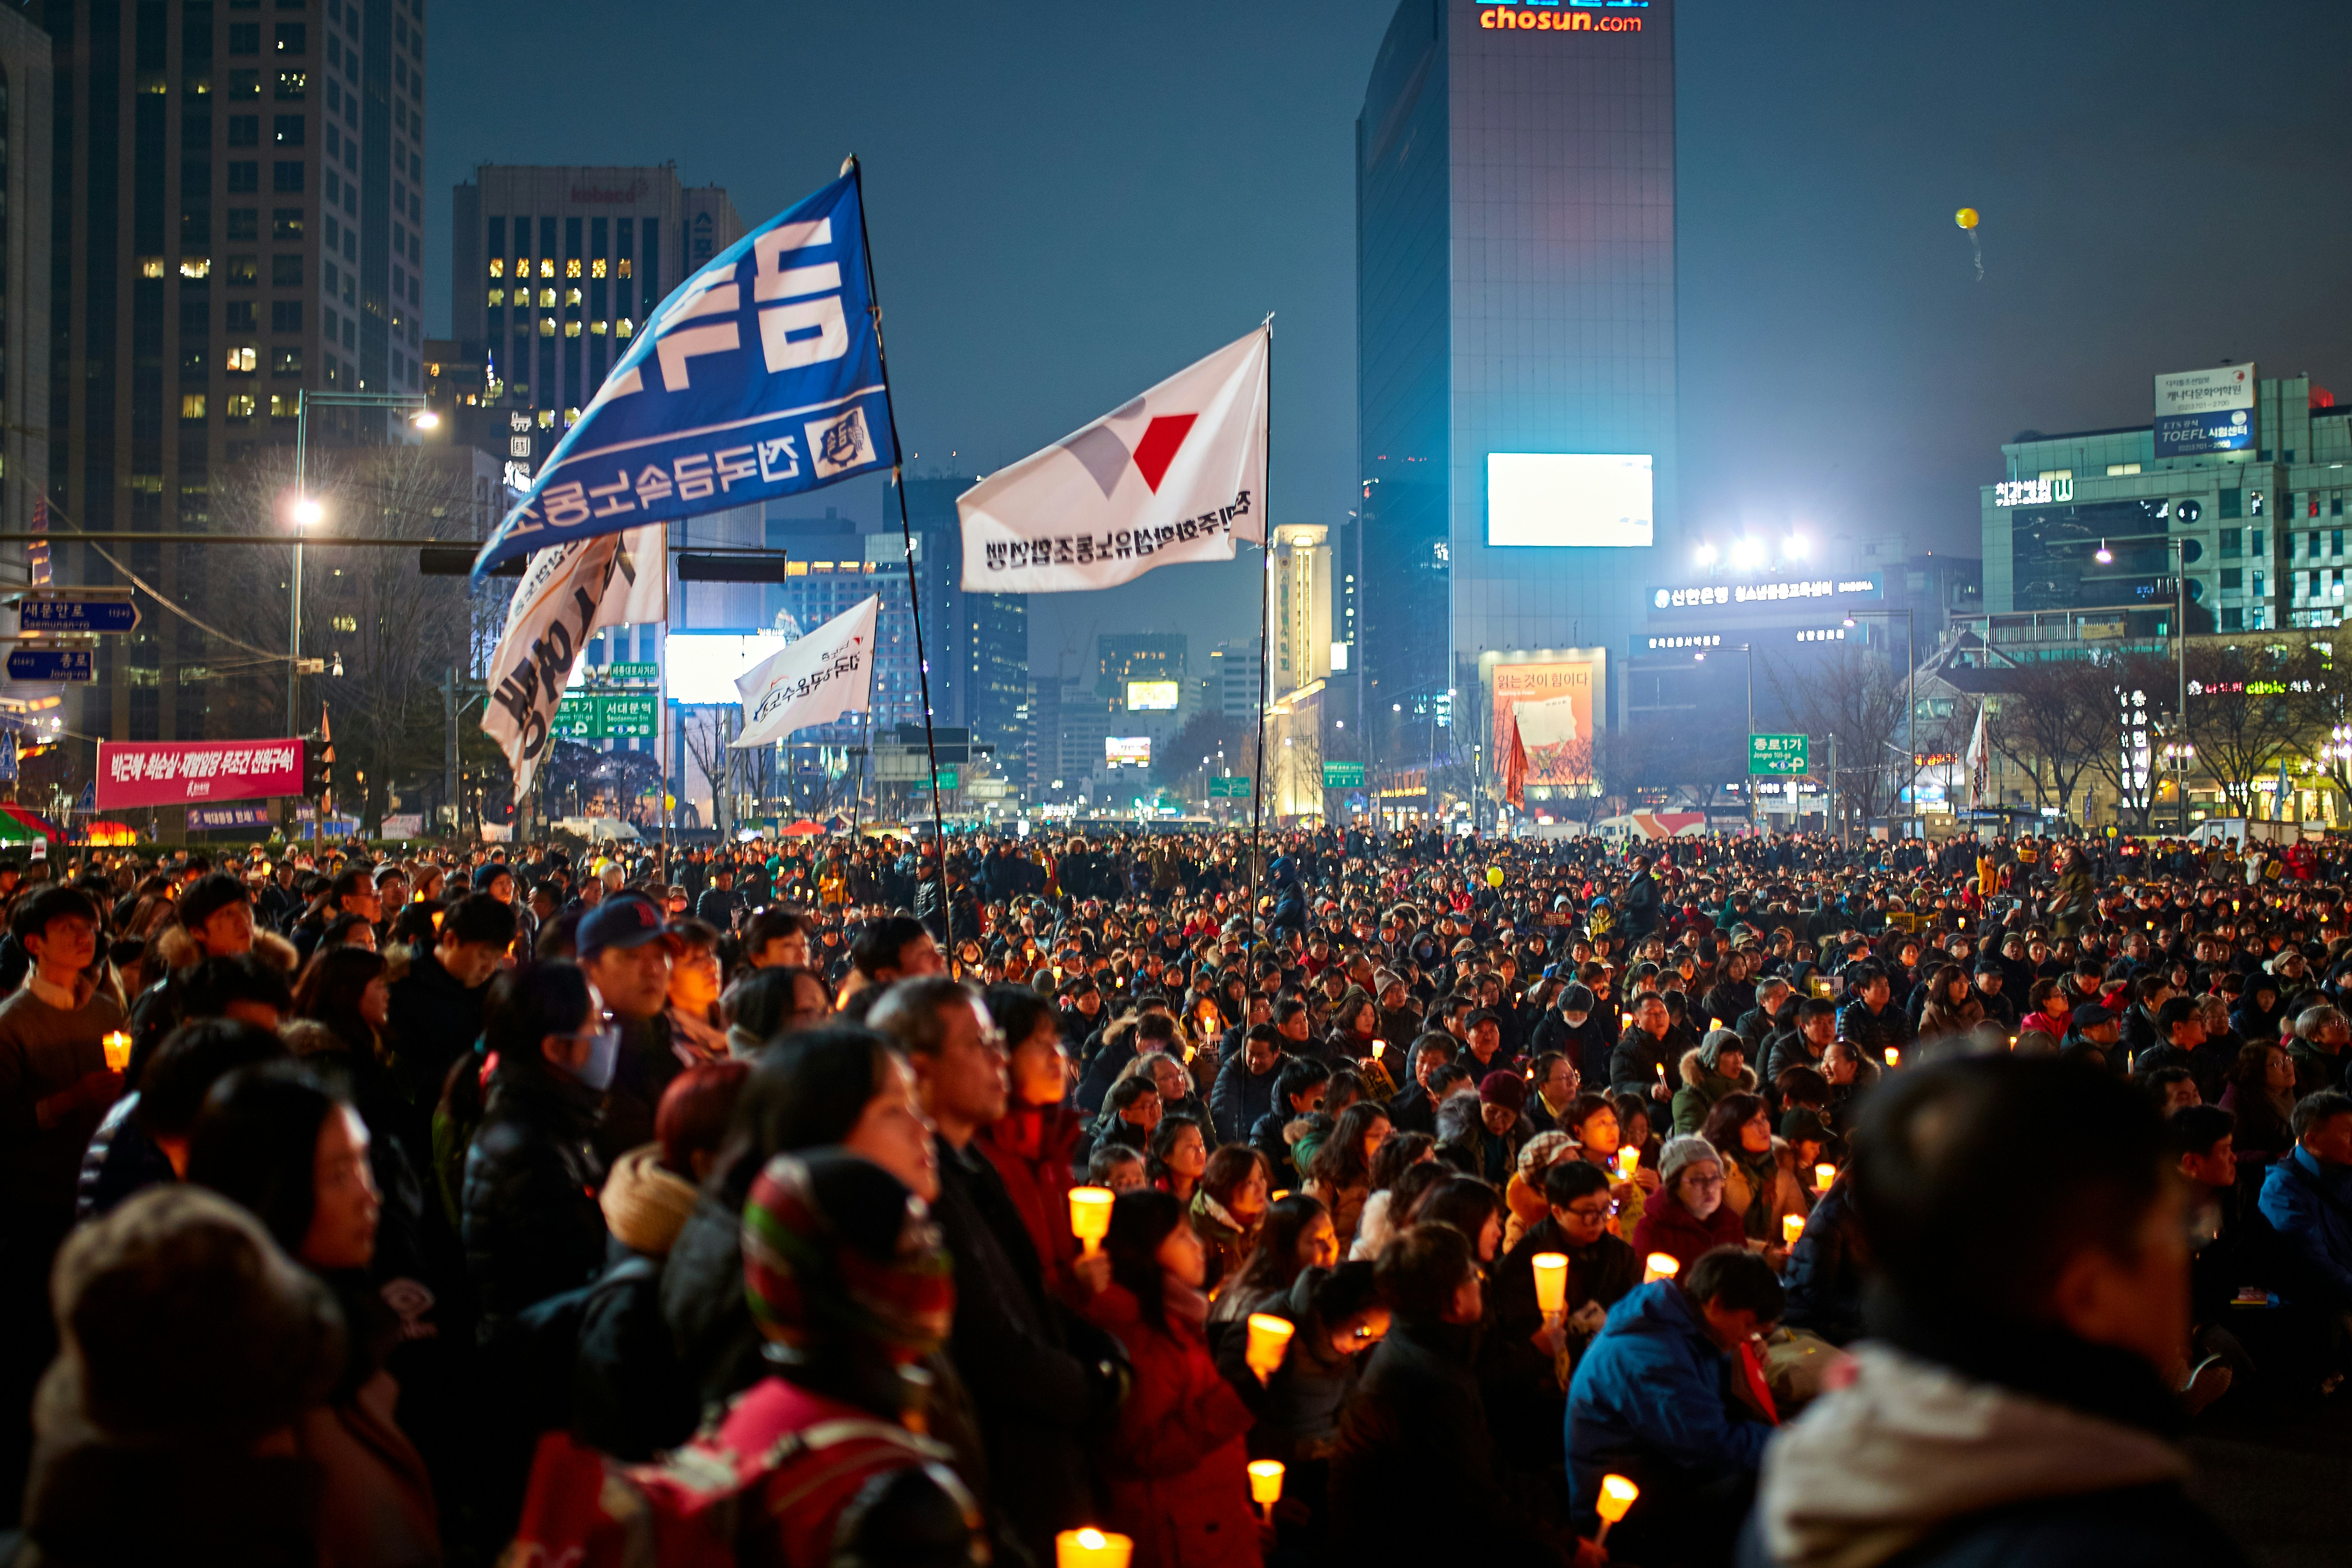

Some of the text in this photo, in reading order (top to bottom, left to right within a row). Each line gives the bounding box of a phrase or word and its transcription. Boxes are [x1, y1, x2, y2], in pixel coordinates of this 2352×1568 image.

[1480, 5, 1641, 32] chosun.com
[2163, 425, 2248, 443] TOEFL 시험센터
[1672, 586, 1729, 606] 신한은행
[25, 602, 84, 618] 새문안로
[61, 653, 87, 668] 종로
[612, 664, 656, 676] 세종대로사거리
[1498, 672, 1588, 689] 읽는 것이 힘이다
[560, 700, 593, 713] 로1가
[606, 701, 651, 715] 서대문역
[1754, 738, 1802, 751] 종로1가
[220, 749, 253, 776] 무조건
[1753, 752, 1772, 760] Jongno
